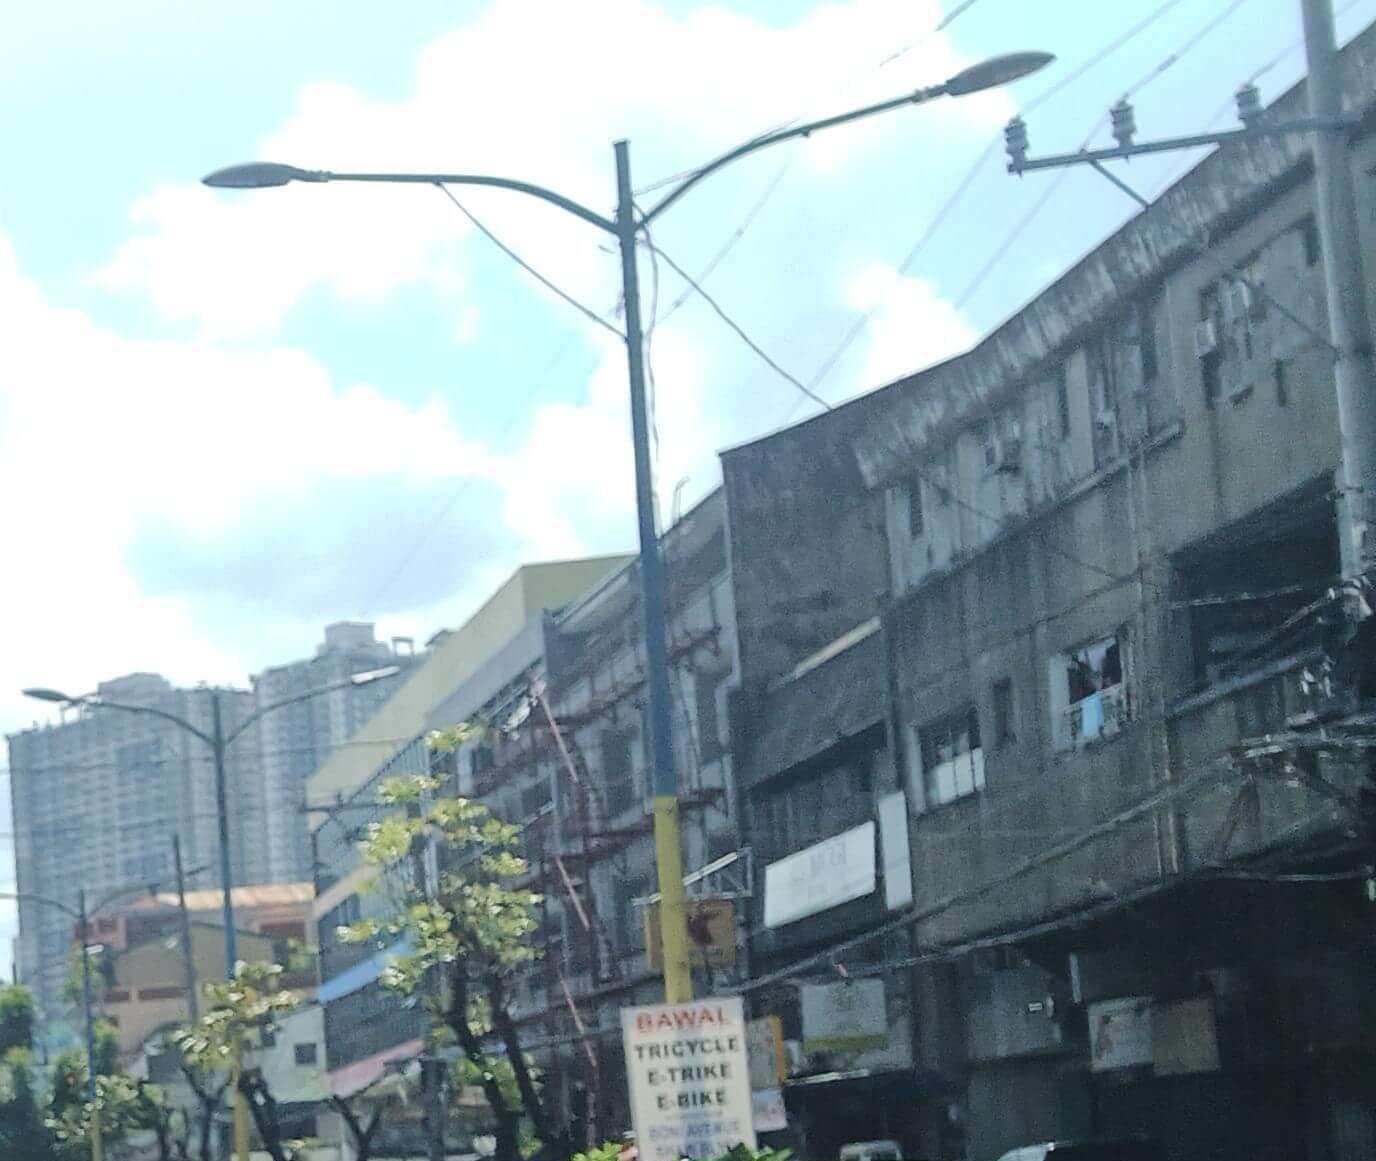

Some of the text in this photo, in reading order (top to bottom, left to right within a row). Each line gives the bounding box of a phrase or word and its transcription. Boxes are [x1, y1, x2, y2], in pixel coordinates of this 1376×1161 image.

[637, 1007, 729, 1033] BAWAL
[635, 1035, 738, 1060] TRICYCLE
[648, 1064, 732, 1085] E-TRIKE
[657, 1090, 726, 1110] E-BIKE
